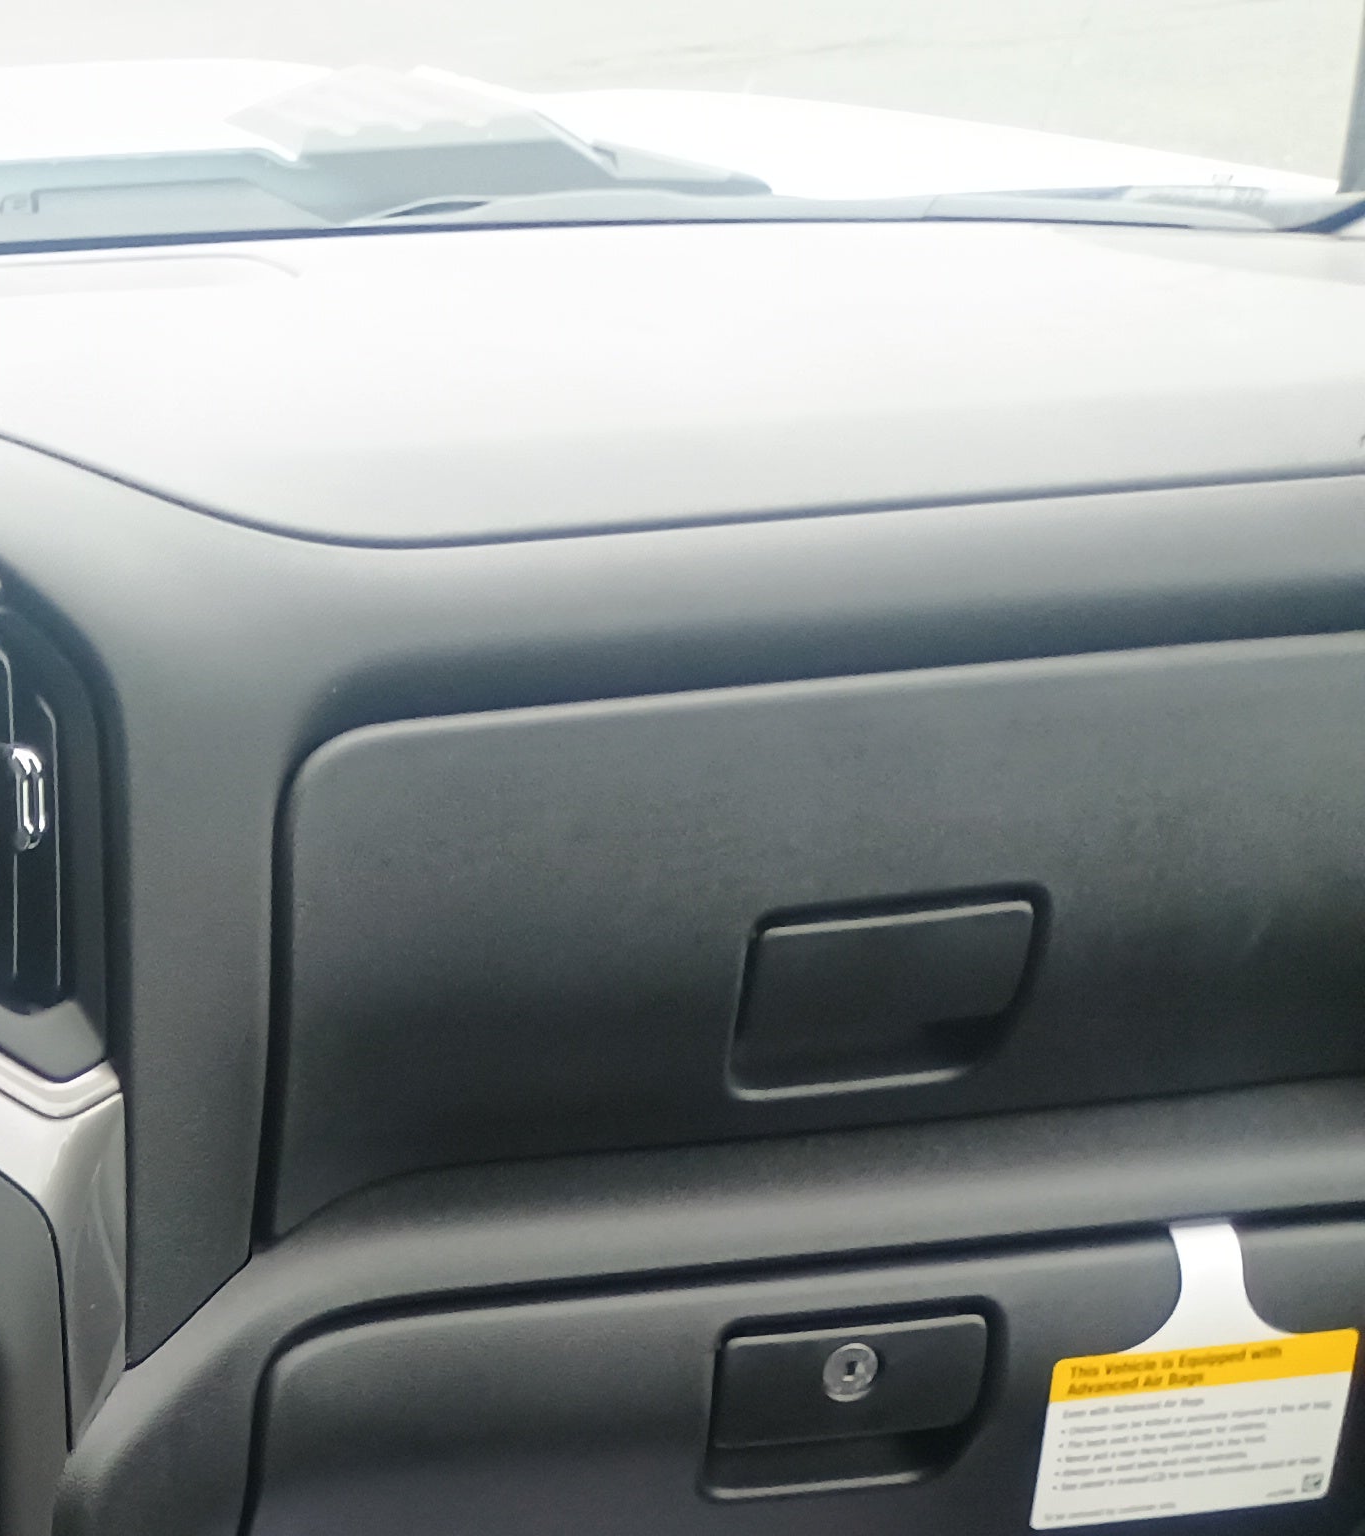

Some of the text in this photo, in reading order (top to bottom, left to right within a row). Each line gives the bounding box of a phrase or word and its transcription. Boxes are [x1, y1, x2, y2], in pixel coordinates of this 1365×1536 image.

[1070, 1365, 1100, 1380] This
[1105, 1359, 1157, 1376] Vehicle
[1179, 1349, 1248, 1369] Equipped
[1067, 1376, 1140, 1397] Advanced
